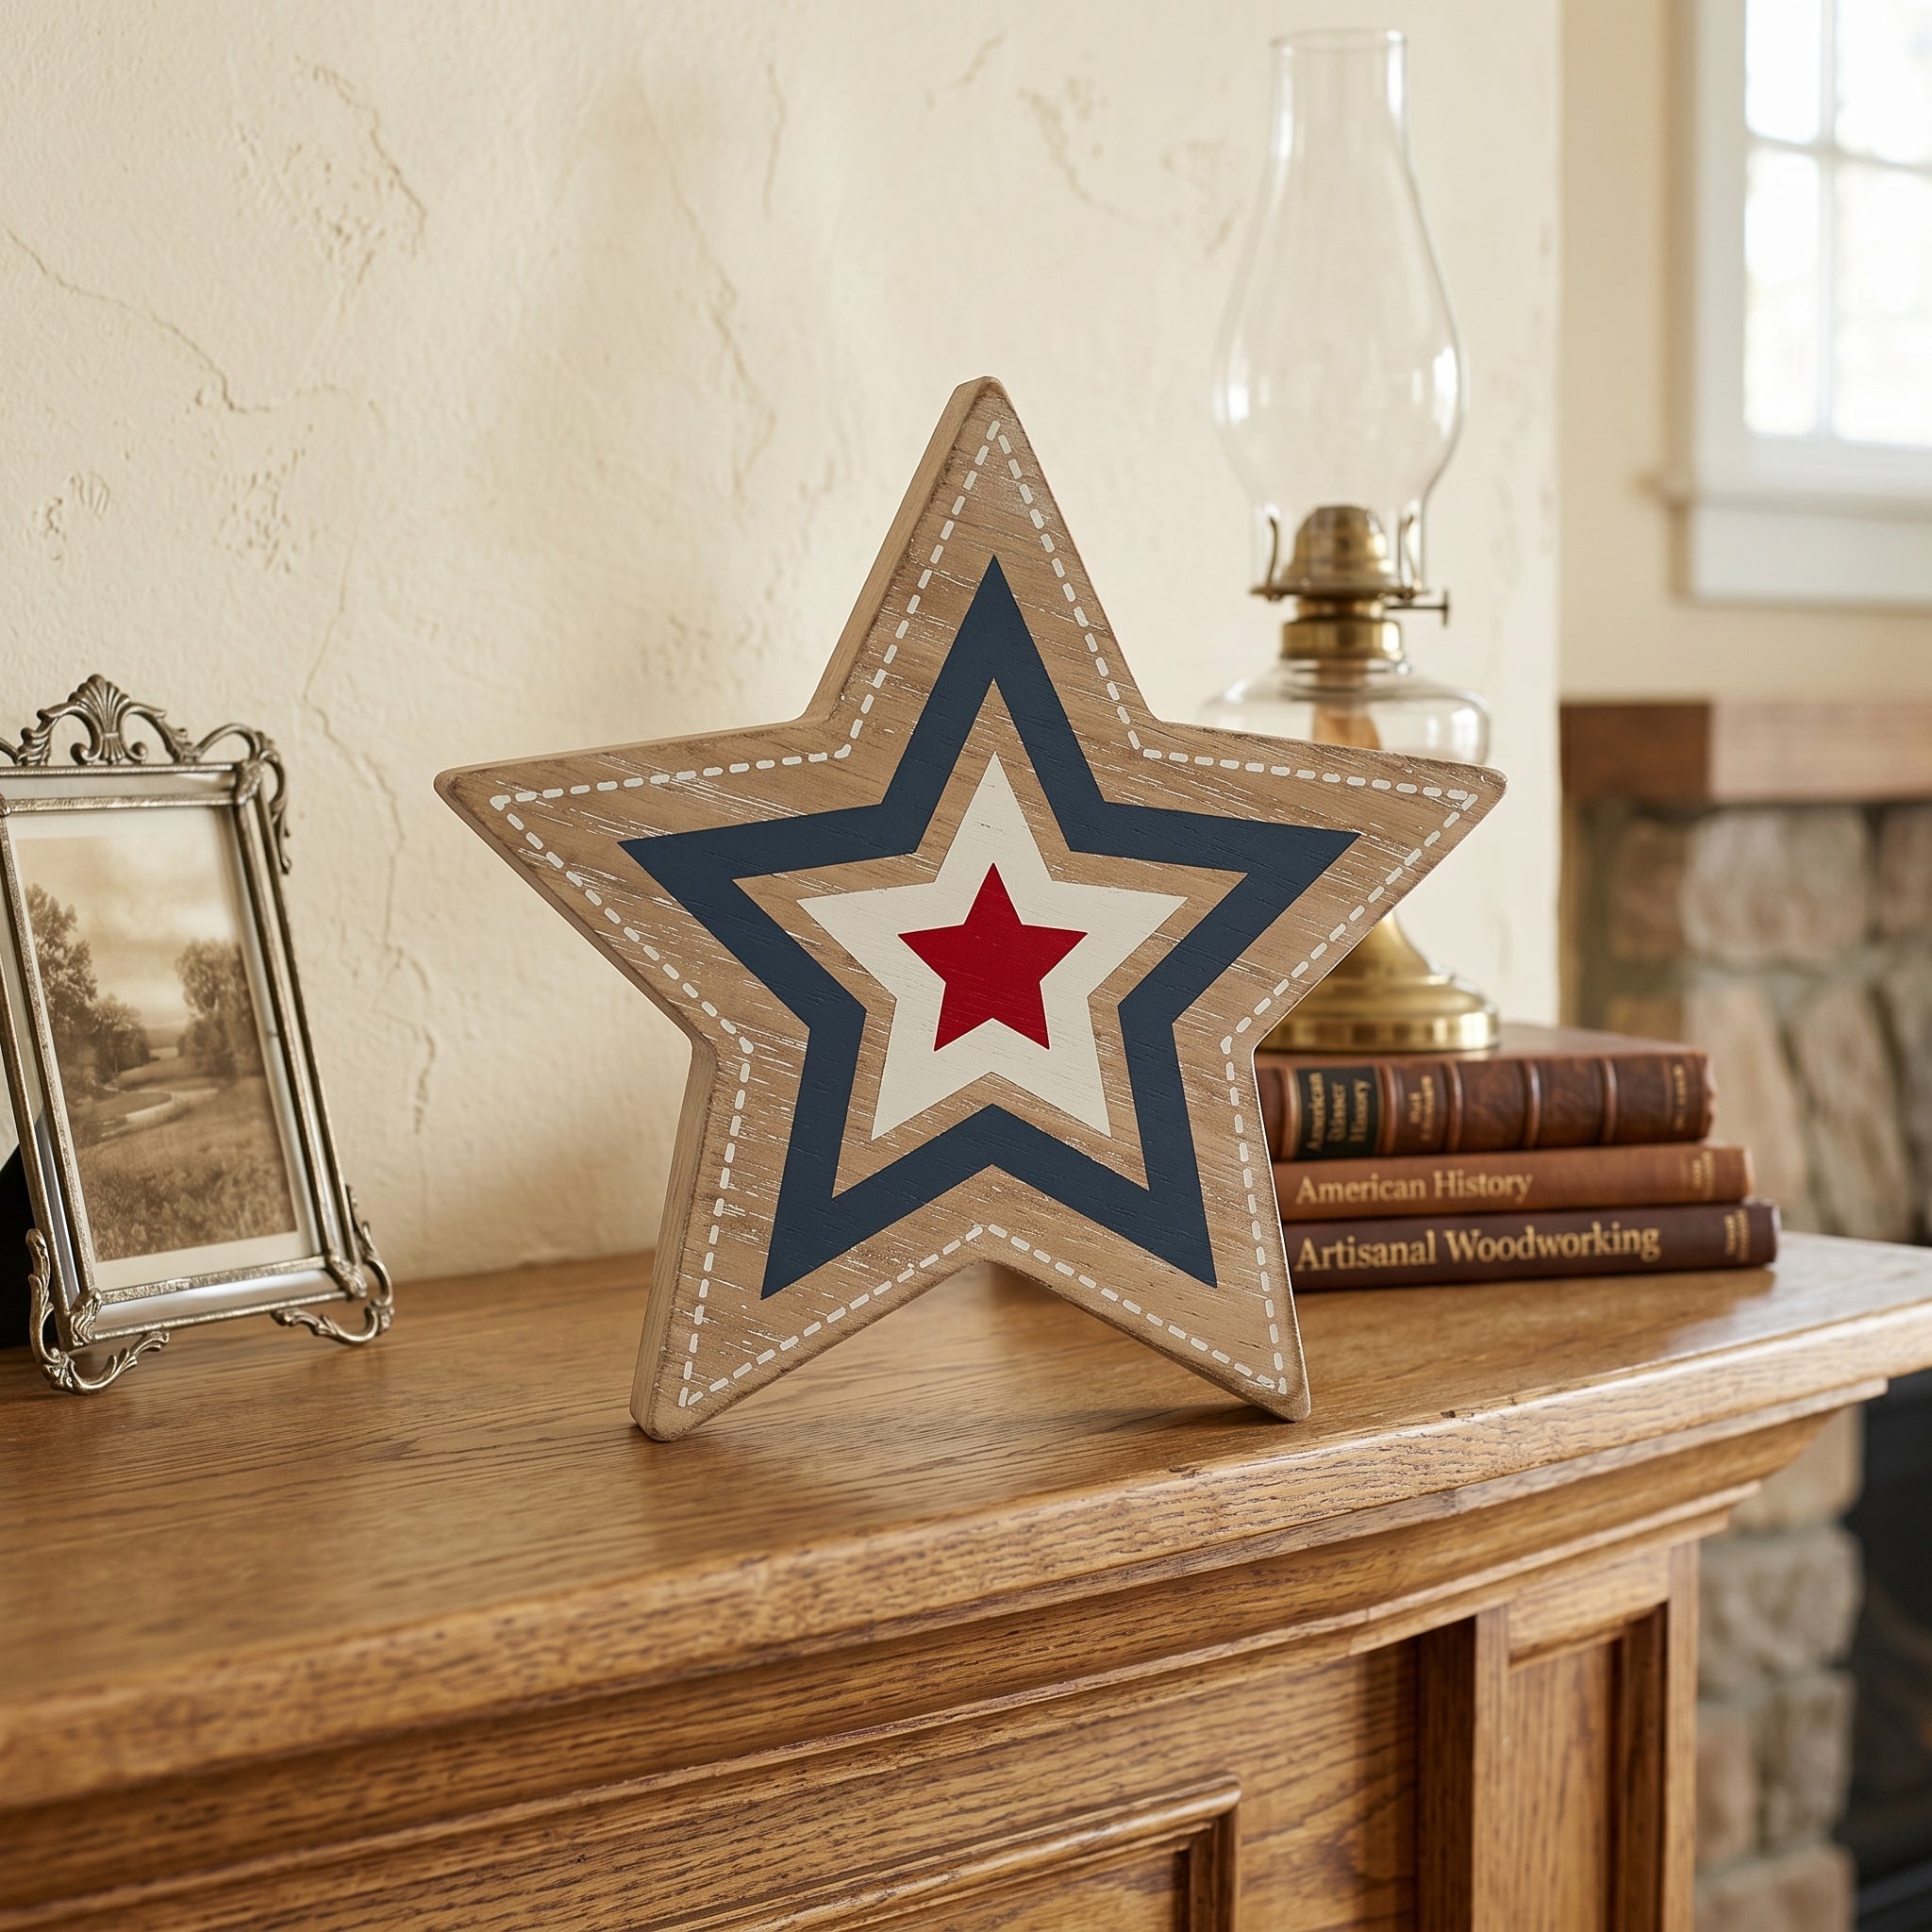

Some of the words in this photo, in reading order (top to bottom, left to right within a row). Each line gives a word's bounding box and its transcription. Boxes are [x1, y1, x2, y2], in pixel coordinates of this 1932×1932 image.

[1307, 1072, 1325, 1151] American
[1295, 1173, 1426, 1205] American
[1432, 1169, 1534, 1204] History
[1294, 1229, 1437, 1272] Artisanal
[1442, 1221, 1661, 1263] Woodworking
